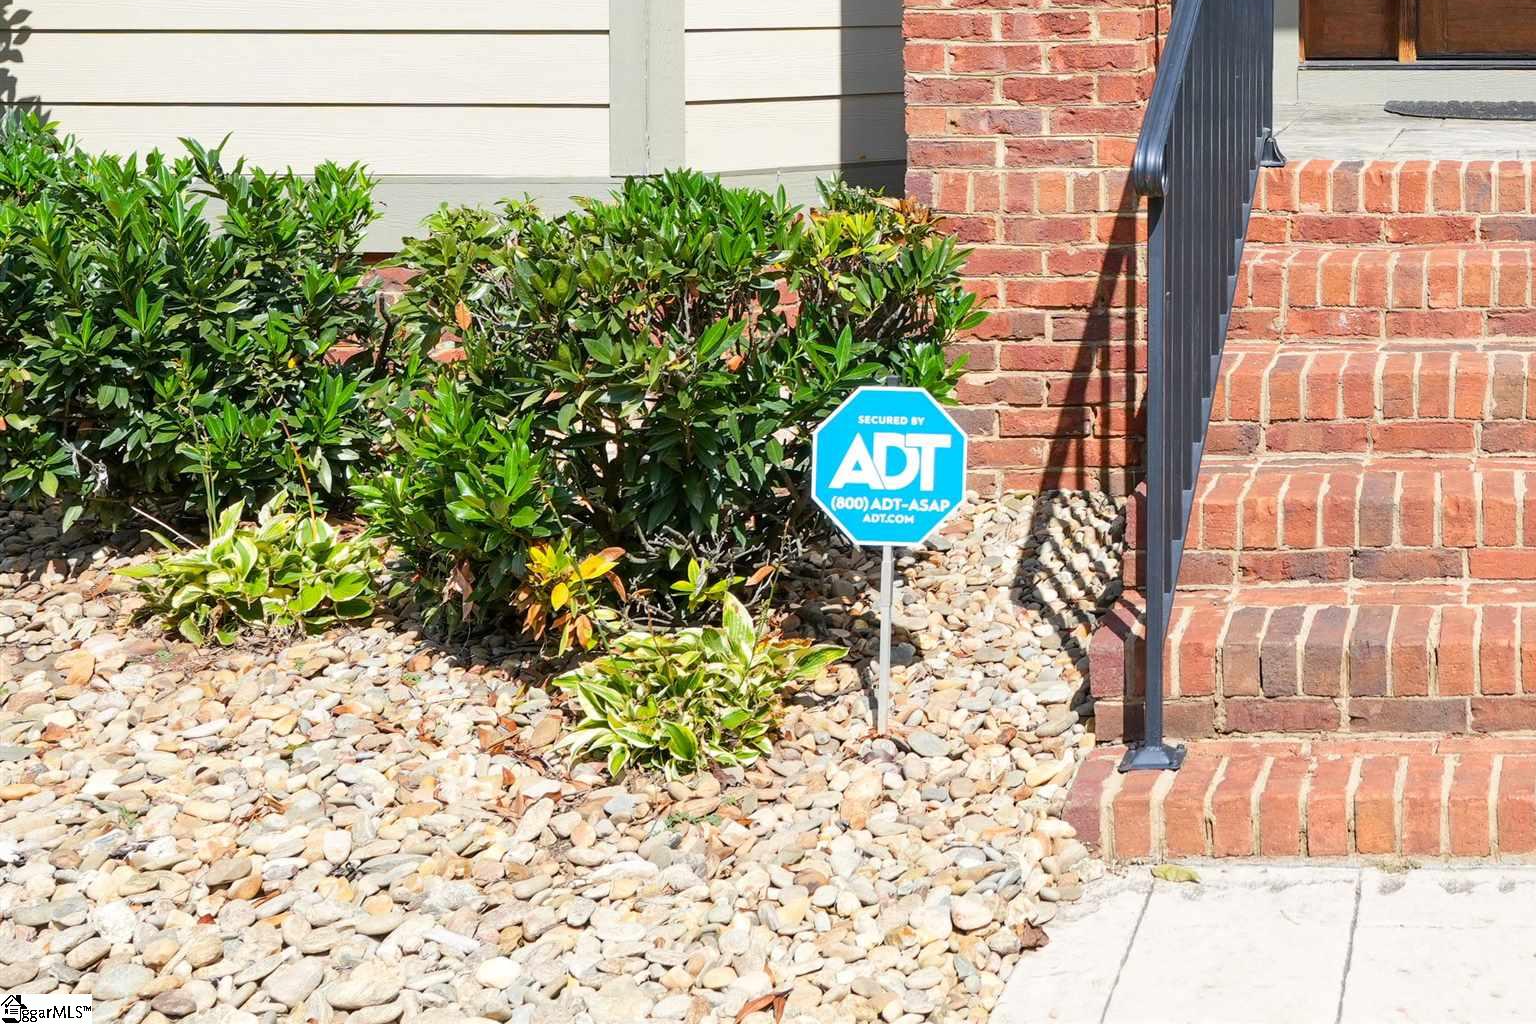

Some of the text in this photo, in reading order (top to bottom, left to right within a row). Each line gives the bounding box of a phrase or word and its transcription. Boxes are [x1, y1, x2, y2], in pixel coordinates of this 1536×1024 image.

[858, 415, 925, 426] SECURED BY
[828, 432, 952, 492] ADT
[831, 496, 950, 513] (800) ADT-ASAP
[862, 513, 914, 524] ADT.COM
